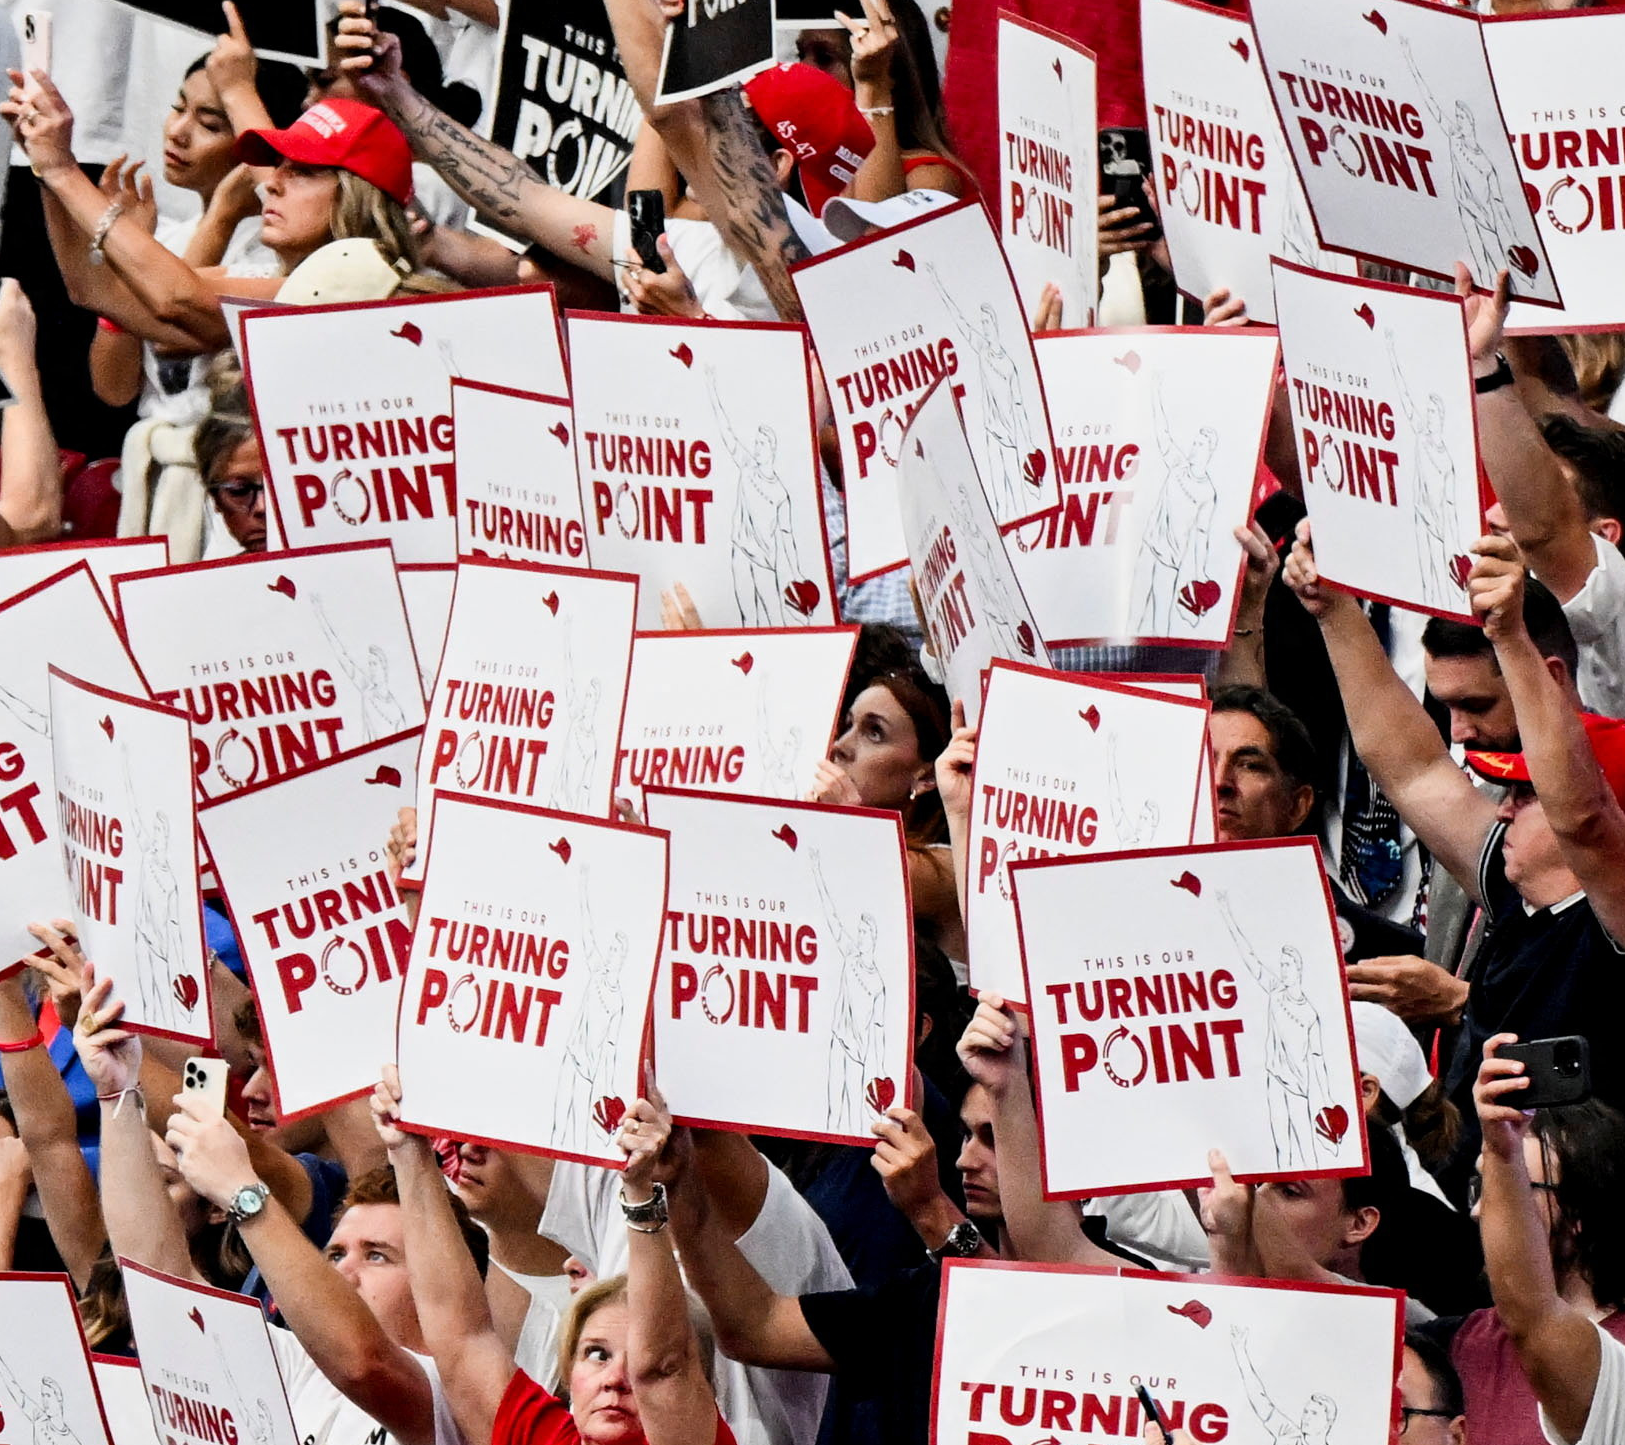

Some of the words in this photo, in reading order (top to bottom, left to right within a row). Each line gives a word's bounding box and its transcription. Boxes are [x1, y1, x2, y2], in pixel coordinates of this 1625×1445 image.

[775, 119, 827, 160] 45-47
[1084, 956, 1125, 971] THIS
[1135, 953, 1152, 967] IS
[1163, 950, 1195, 964] OUR
[1046, 969, 1238, 1024] TURNING
